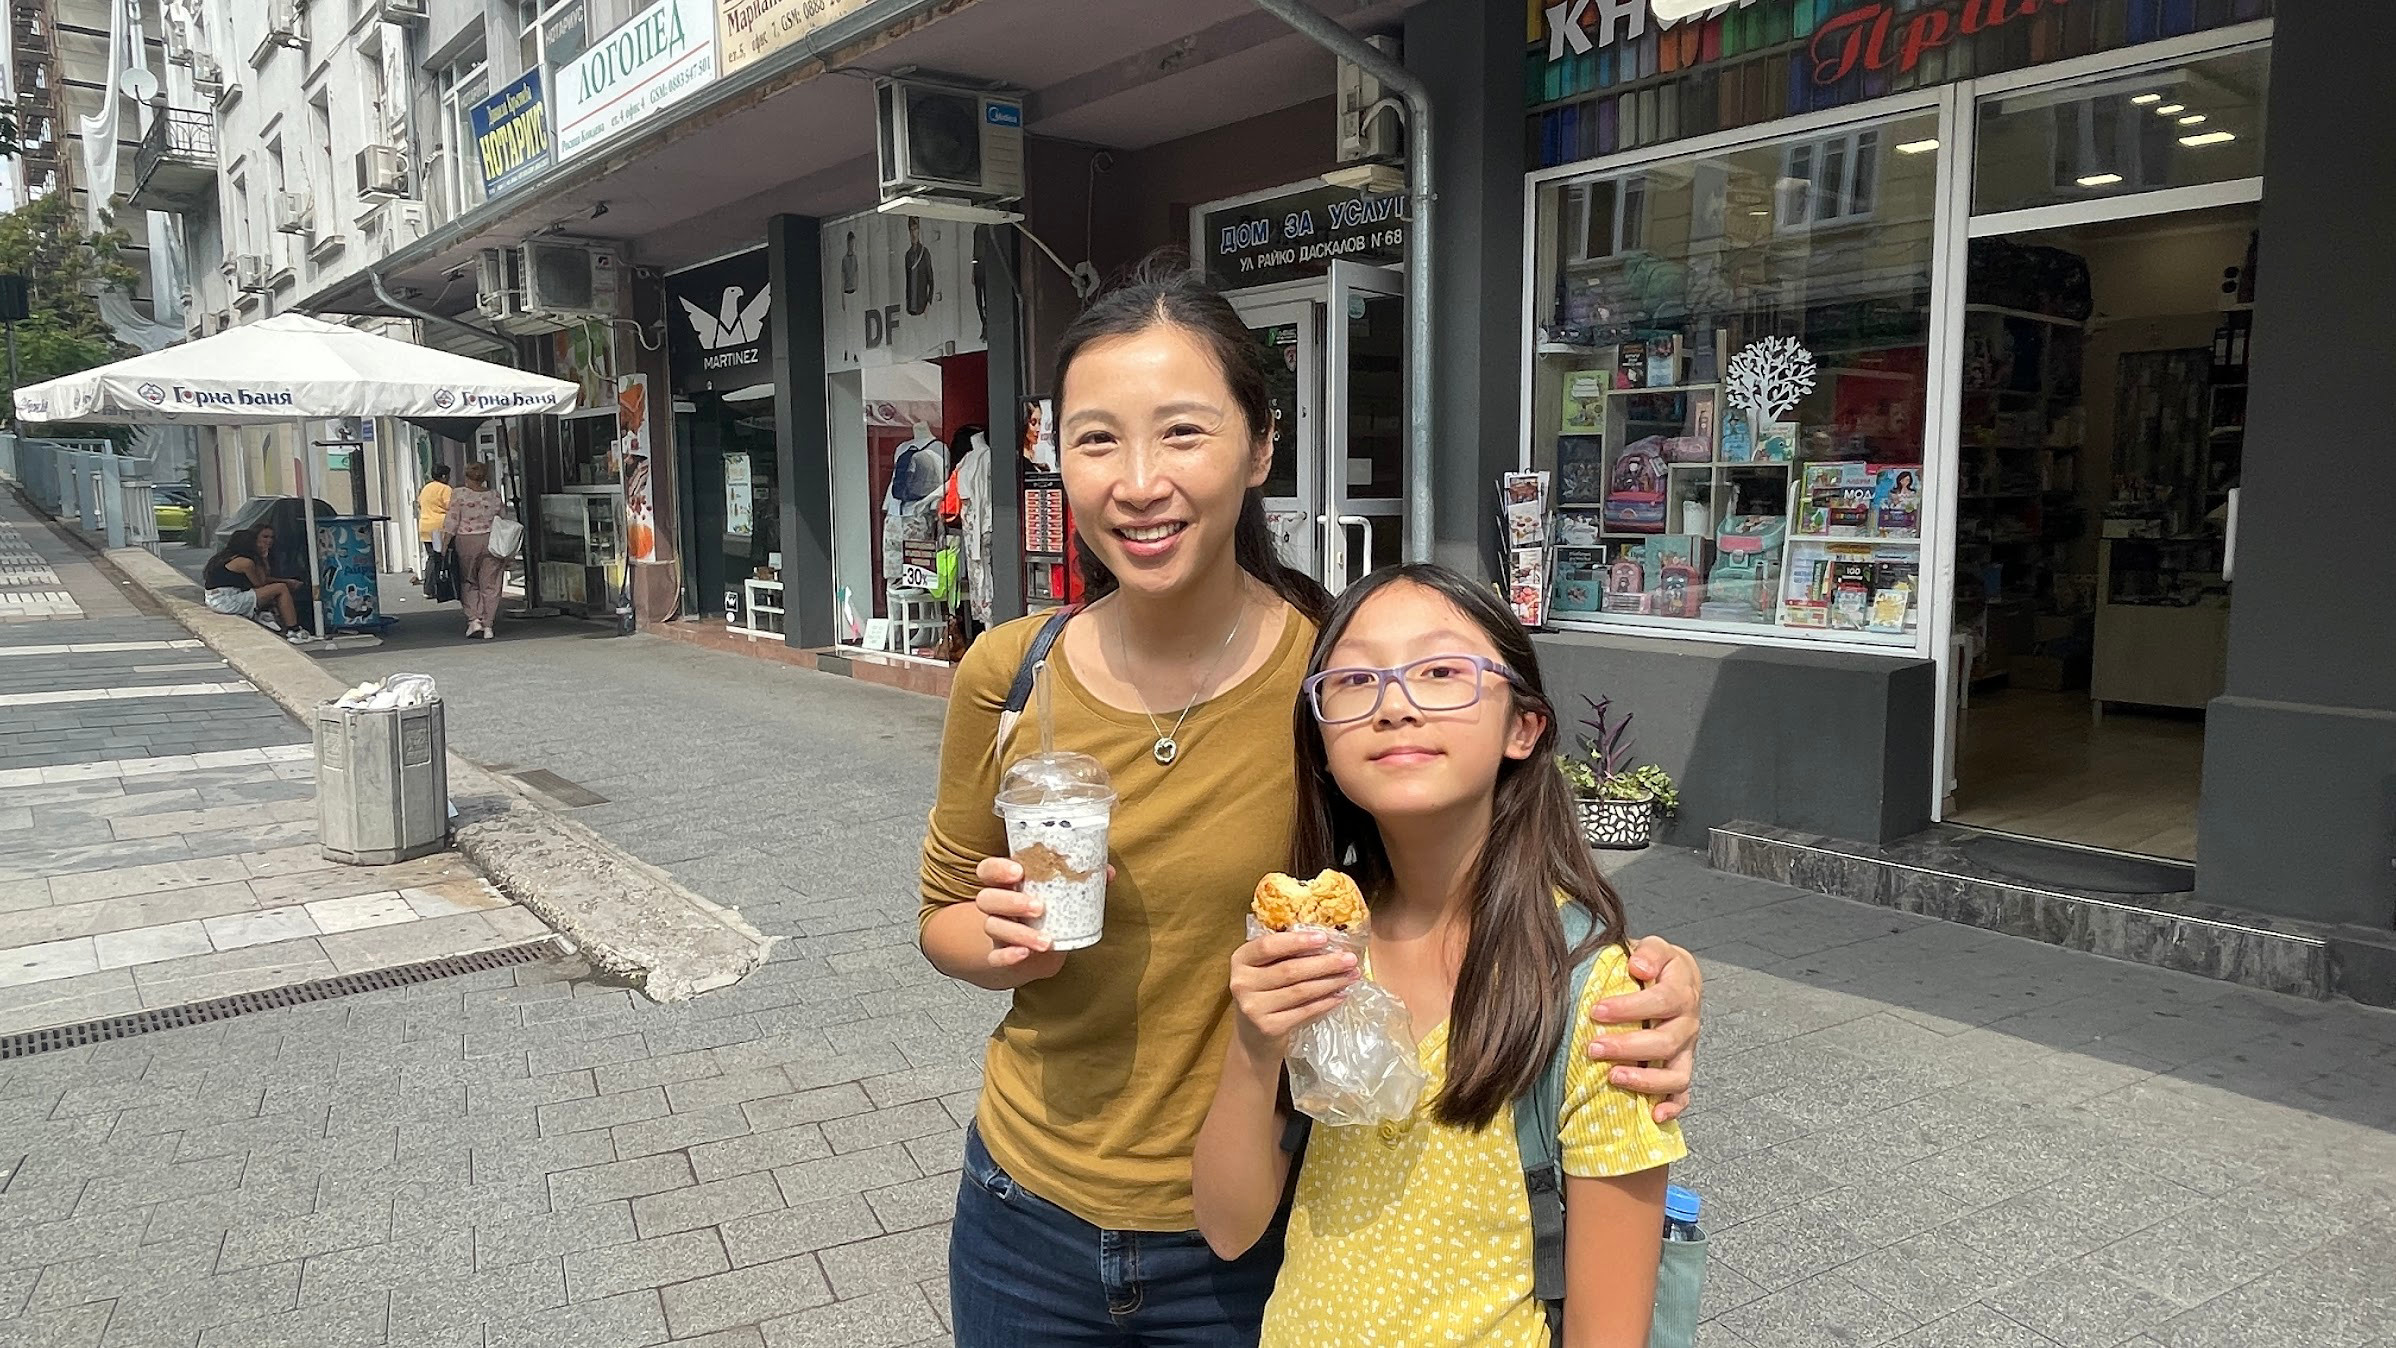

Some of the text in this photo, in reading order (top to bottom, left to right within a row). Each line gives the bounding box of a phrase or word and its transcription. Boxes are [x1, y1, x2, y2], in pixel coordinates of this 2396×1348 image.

[577, 0, 685, 105] ЛОГОПЕД
[479, 101, 548, 180] НОТАРИУС
[1221, 219, 1269, 254] ДОМ
[1283, 210, 1315, 239] ЗА
[1257, 248, 1296, 269] РАЙКО
[1299, 235, 1366, 264] ДАСКАЛОВ
[864, 304, 901, 349] DF
[703, 348, 759, 370] MARTINEZ
[173, 386, 293, 408] Горна Баня
[513, 391, 558, 407] Баня
